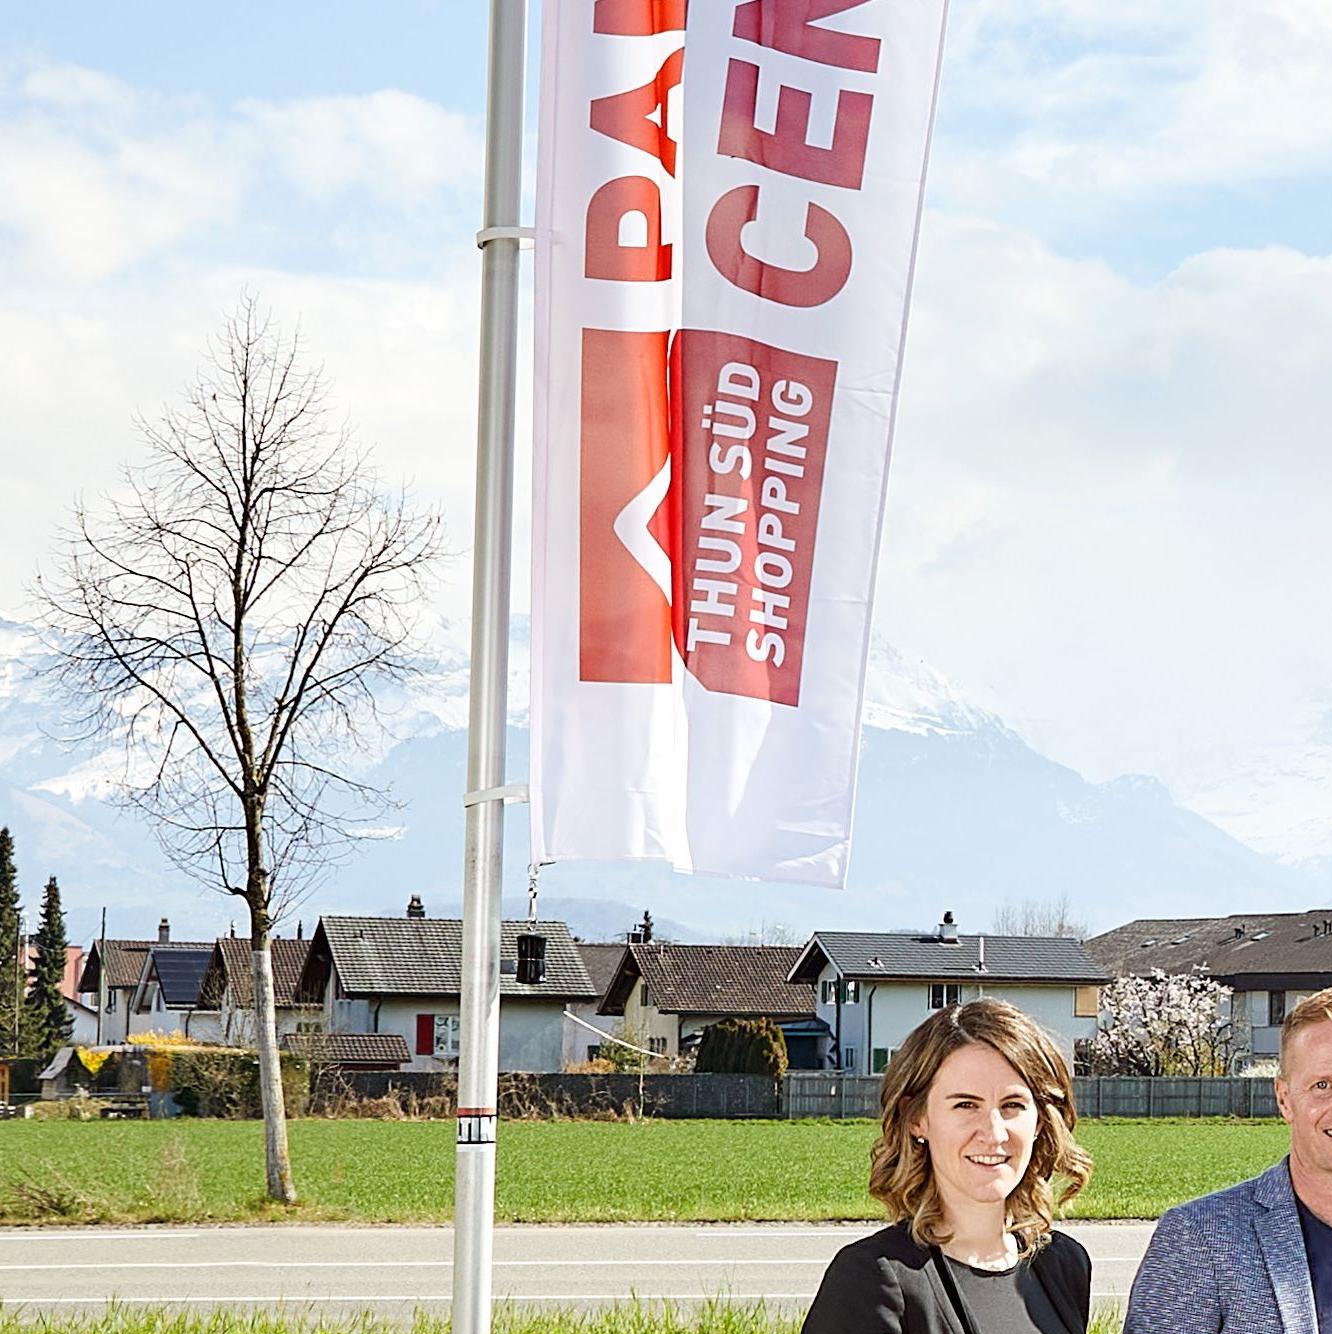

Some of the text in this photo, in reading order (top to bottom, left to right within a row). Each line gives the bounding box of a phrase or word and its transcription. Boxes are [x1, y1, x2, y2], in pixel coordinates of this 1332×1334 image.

[687, 361, 761, 652] THUN SÜD
[745, 379, 813, 668] SHOPPING
